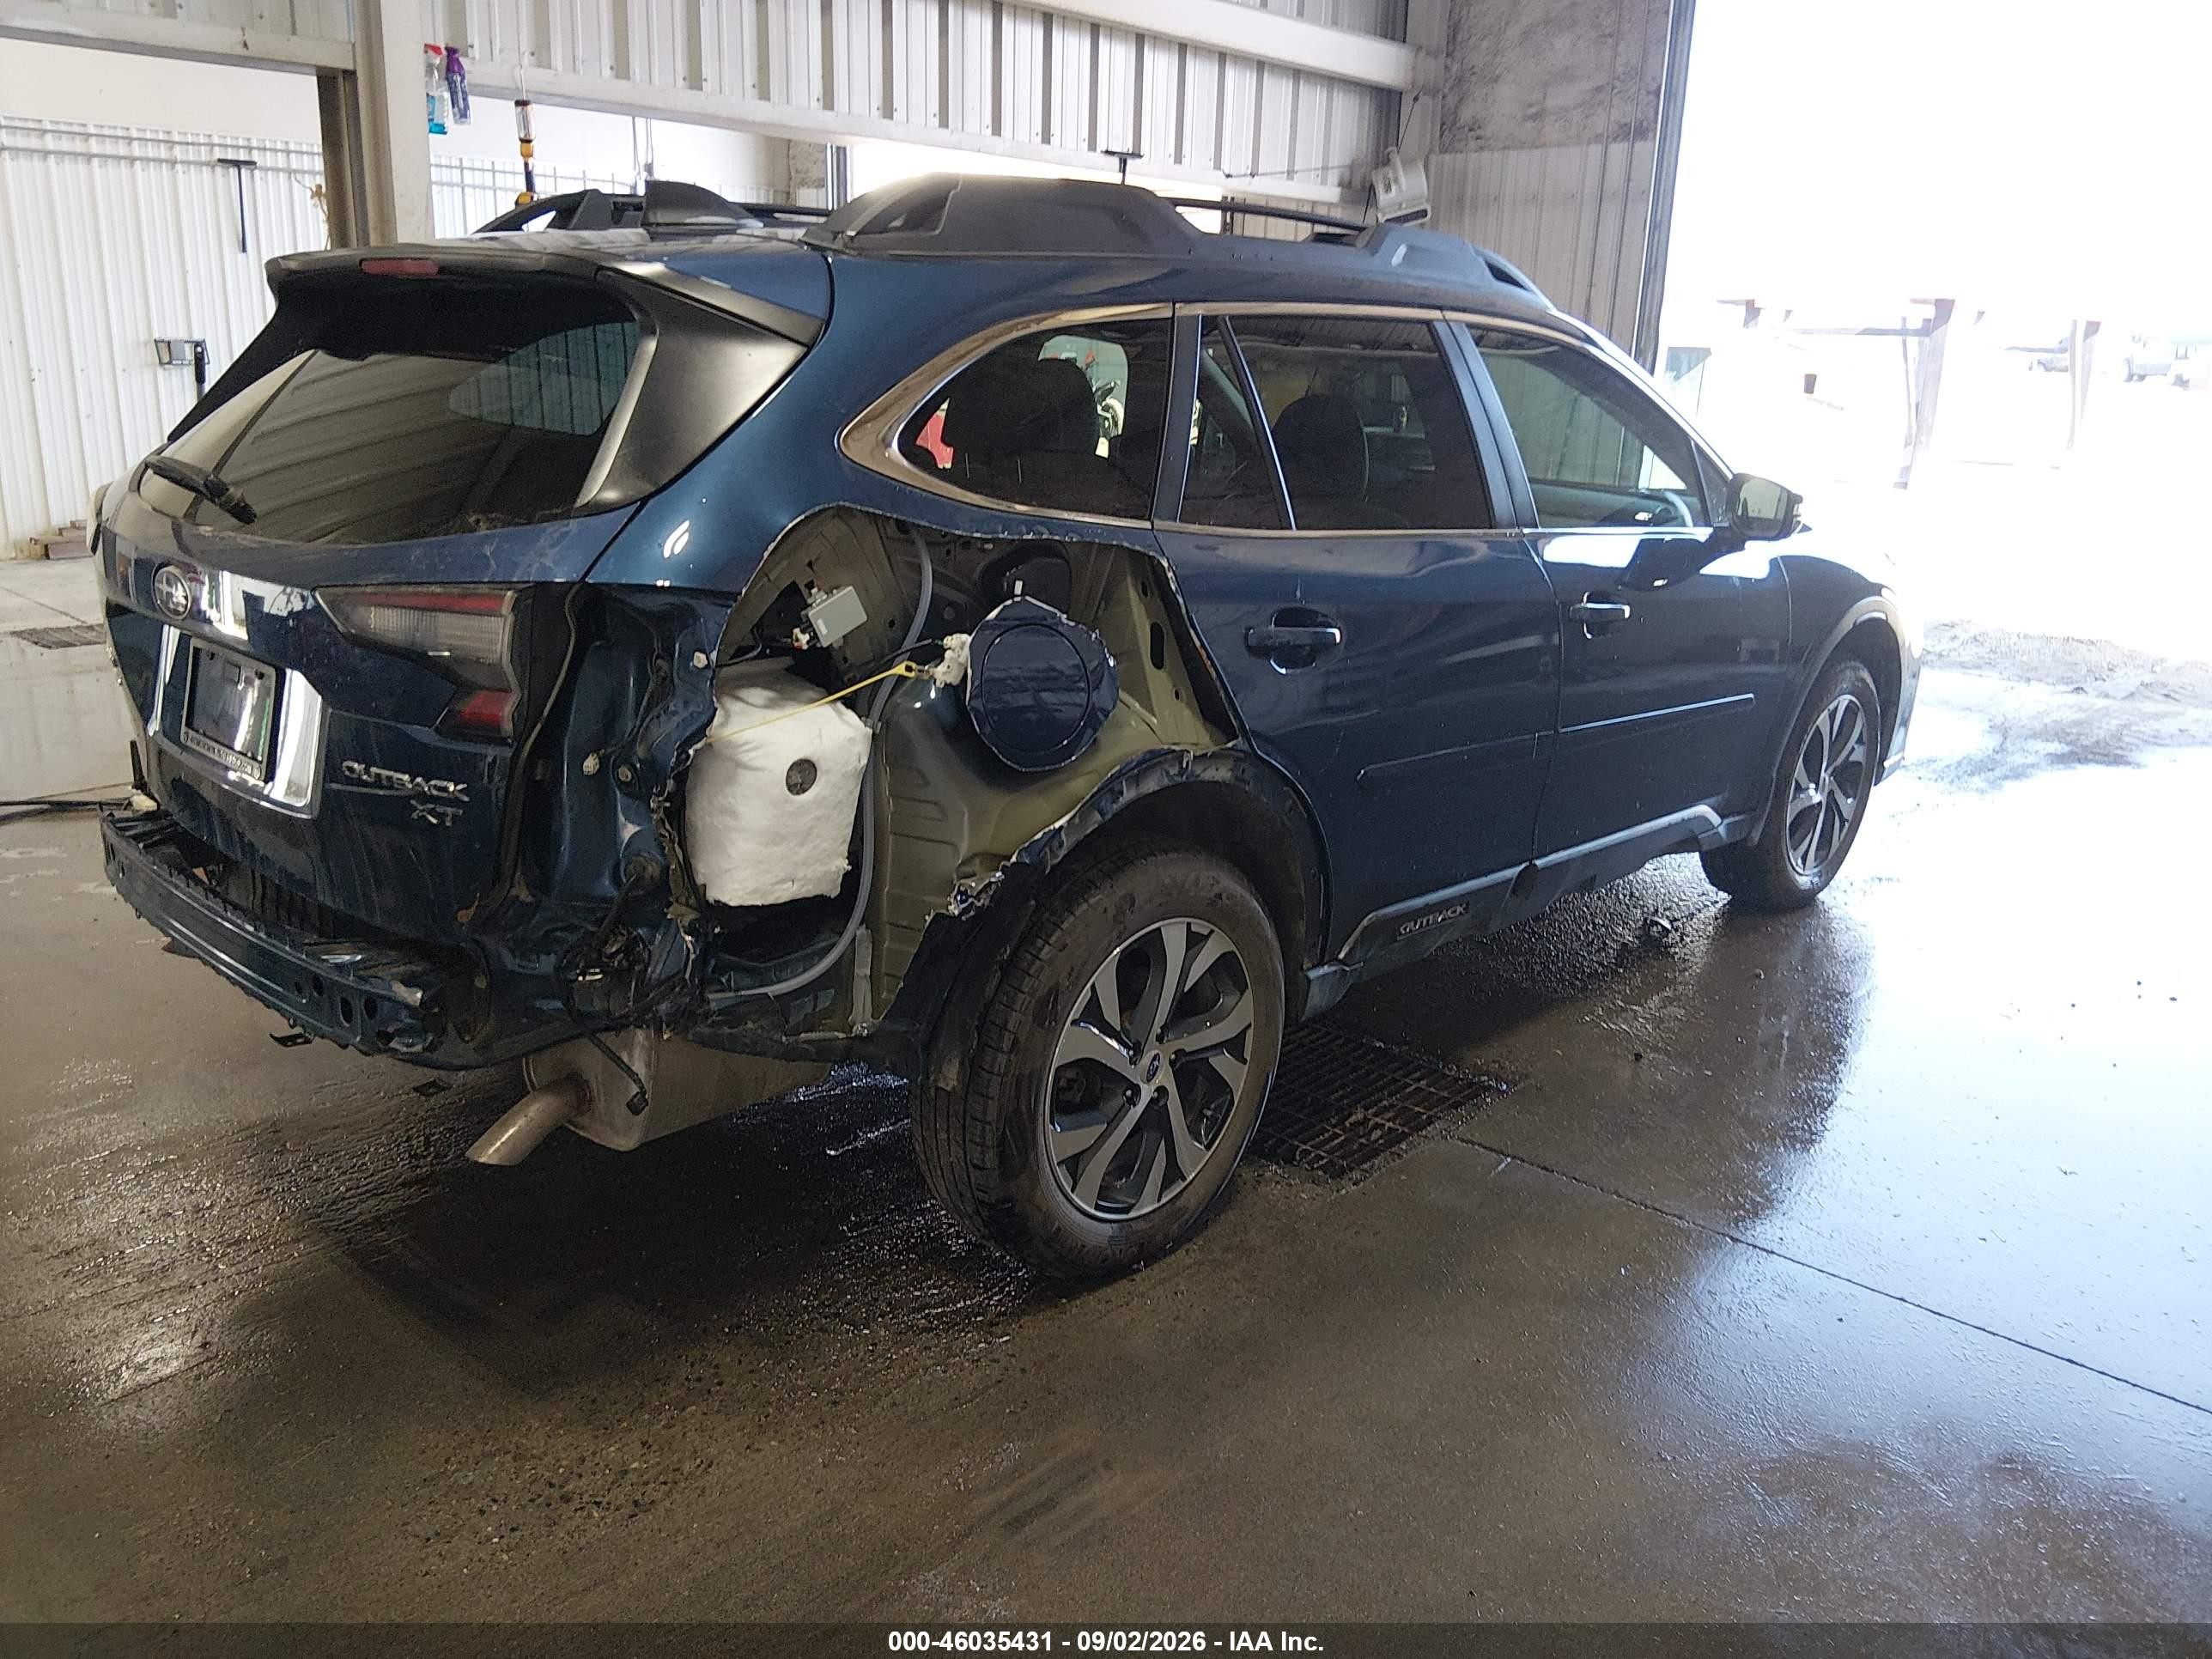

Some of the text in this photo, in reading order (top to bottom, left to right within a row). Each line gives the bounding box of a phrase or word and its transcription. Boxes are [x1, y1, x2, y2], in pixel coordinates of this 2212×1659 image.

[342, 760, 471, 802] OUTBACK
[410, 799, 464, 827] XT
[1399, 901, 1469, 935] OUTBACK
